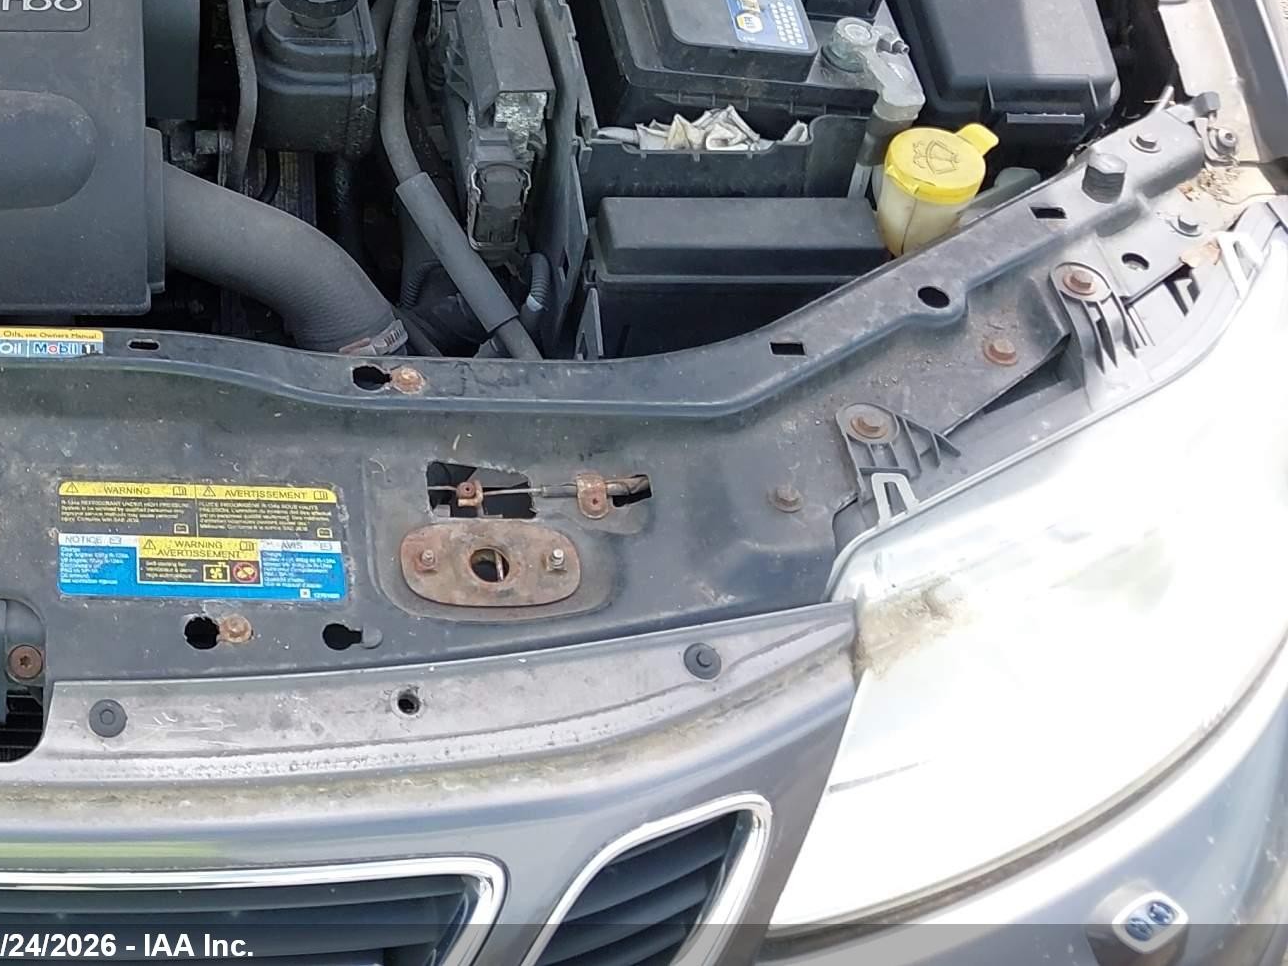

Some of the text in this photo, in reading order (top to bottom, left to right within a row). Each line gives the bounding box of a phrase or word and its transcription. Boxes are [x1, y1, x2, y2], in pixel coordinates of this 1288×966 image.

[33, 342, 78, 355] Mobil
[103, 486, 151, 495] WARNING
[224, 489, 306, 499] AVERTISSEMENT
[65, 536, 103, 544] NOTICE
[174, 540, 223, 549] WARNING
[281, 542, 303, 550] AVIS
[156, 549, 241, 559] AVERTISSEMENT
